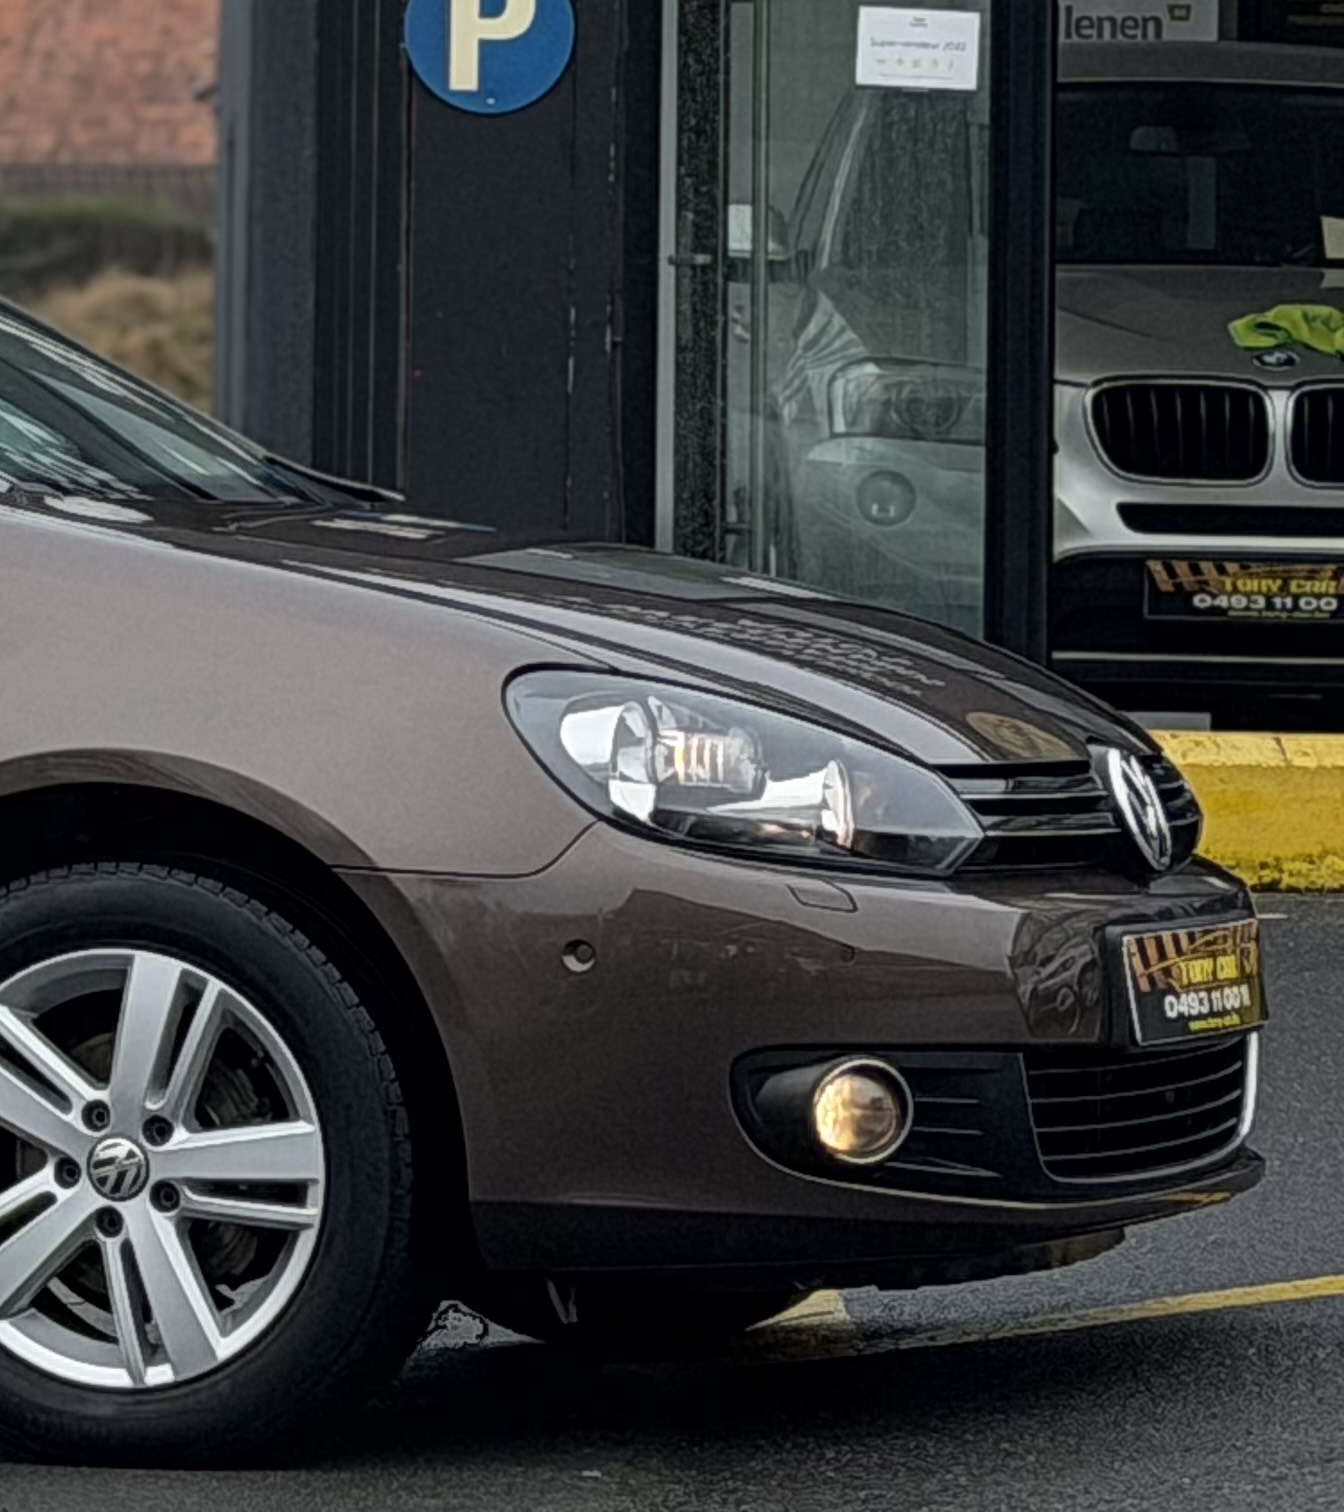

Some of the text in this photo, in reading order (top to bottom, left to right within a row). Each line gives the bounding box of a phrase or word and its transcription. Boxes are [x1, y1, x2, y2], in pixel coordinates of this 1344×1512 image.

[1064, 5, 1164, 40] lenen
[1272, 595, 1293, 609] 11
[1164, 990, 1210, 1019] 0493
